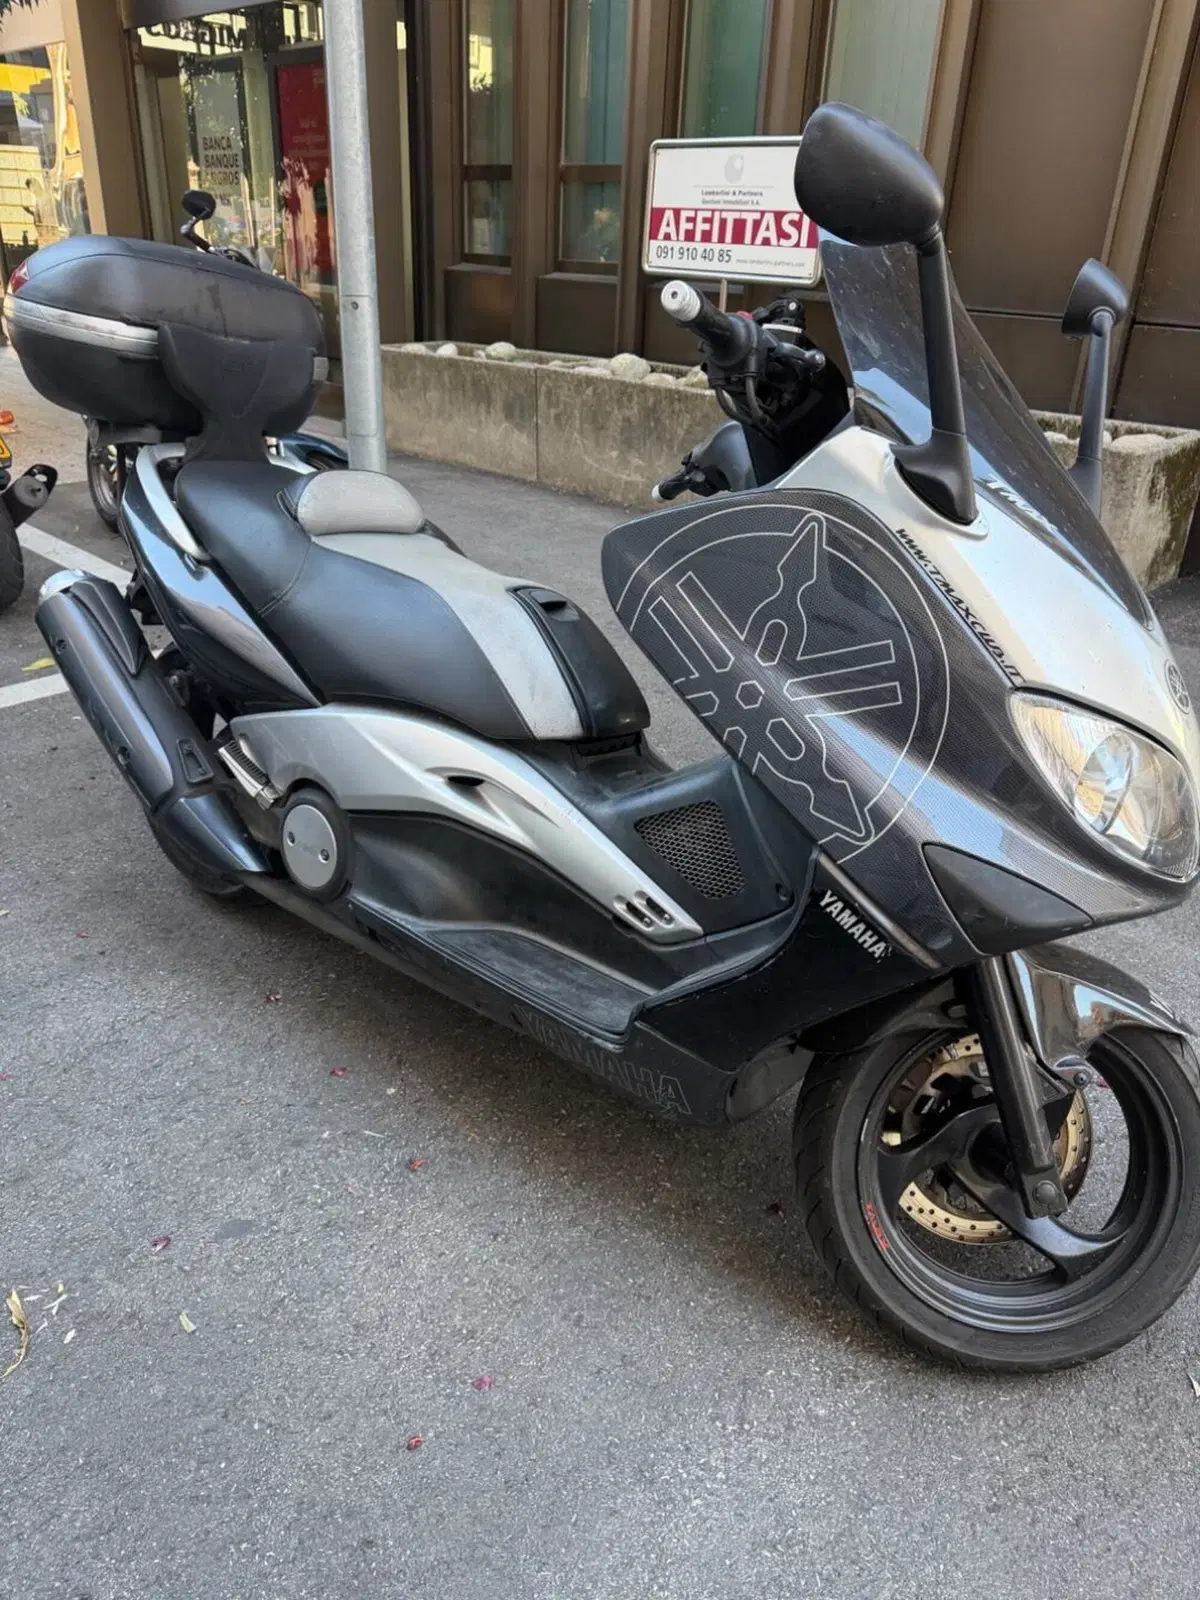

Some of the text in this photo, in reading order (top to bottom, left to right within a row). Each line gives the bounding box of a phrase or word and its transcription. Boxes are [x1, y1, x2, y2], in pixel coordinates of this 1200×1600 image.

[203, 136, 232, 151] BANCA
[204, 153, 240, 168] BANQUE
[657, 209, 810, 248] AFFITTASI
[656, 245, 674, 260] 091
[678, 246, 698, 261] 910
[700, 248, 715, 262] 40
[717, 249, 732, 263] 85
[819, 889, 888, 960] YAMAHA
[513, 1003, 692, 1116] YAMAHA
